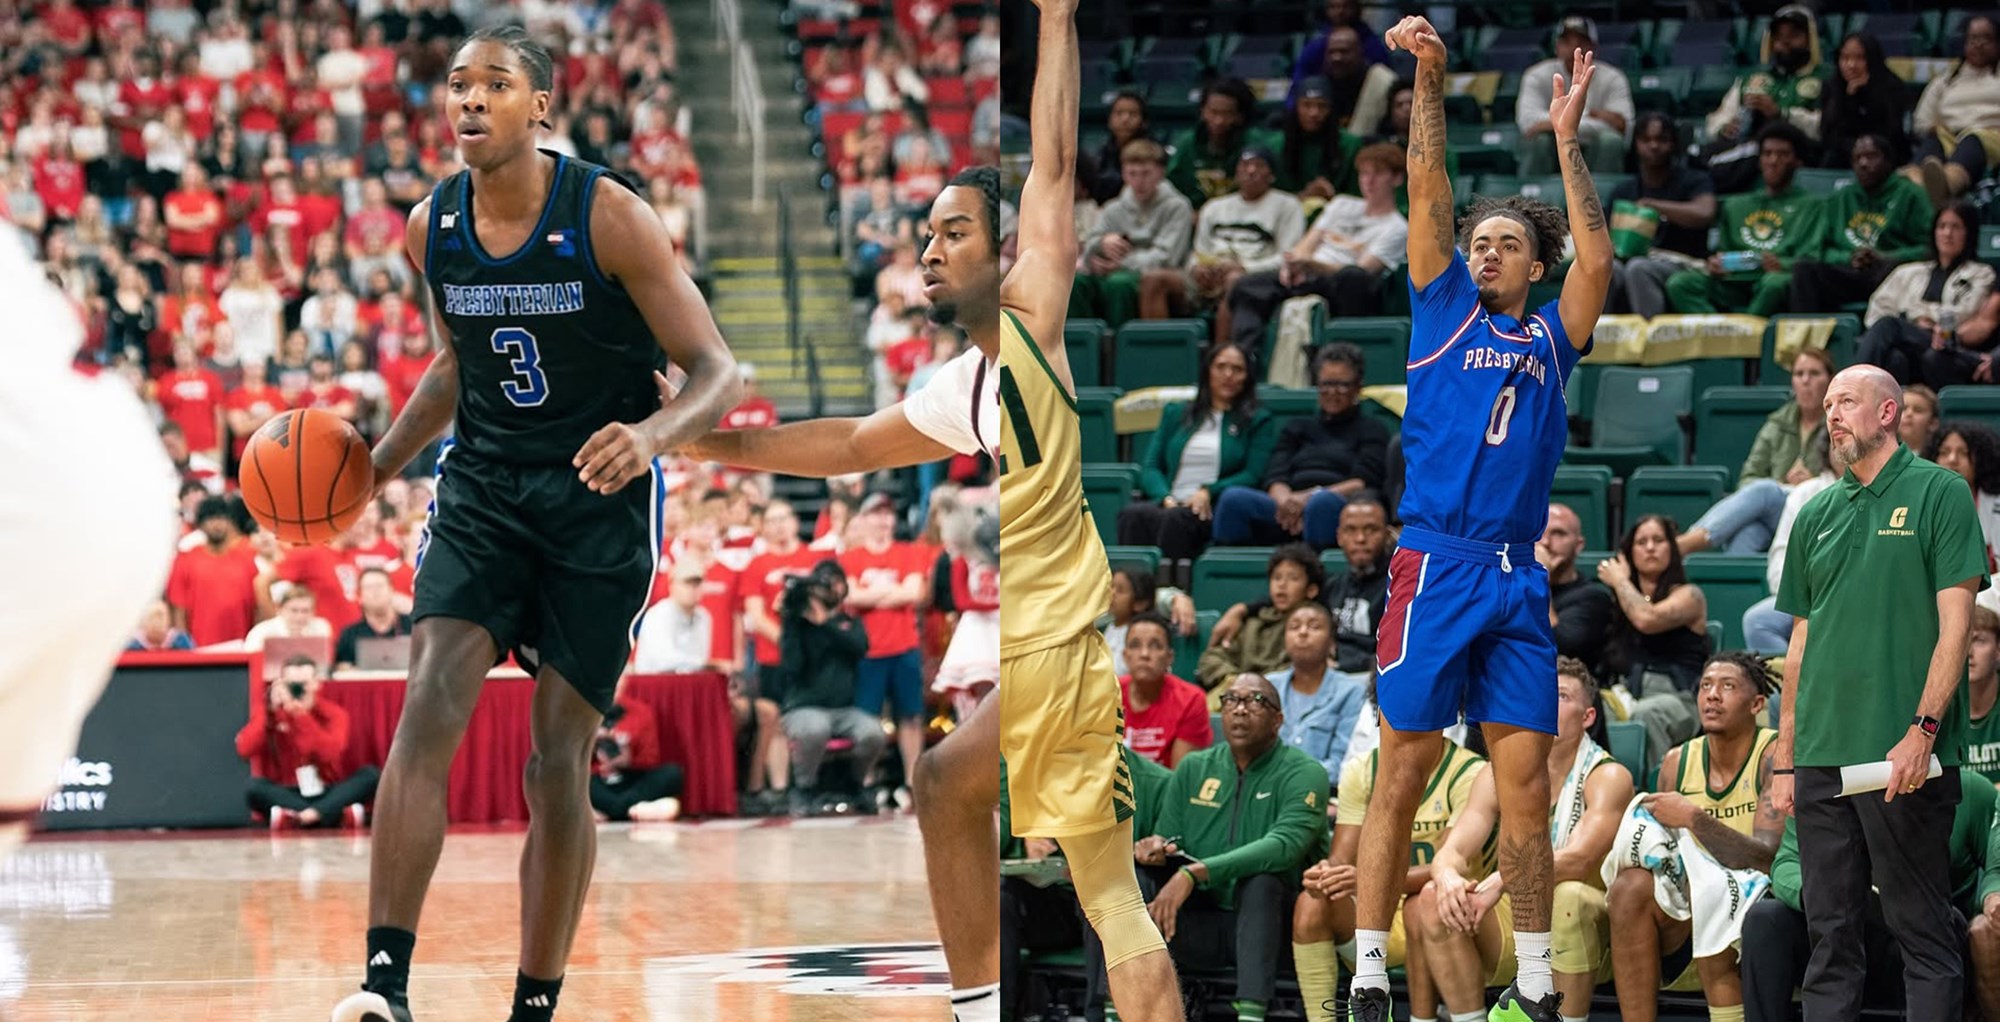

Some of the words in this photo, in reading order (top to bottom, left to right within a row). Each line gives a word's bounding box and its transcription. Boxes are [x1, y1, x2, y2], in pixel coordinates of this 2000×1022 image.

[443, 281, 585, 316] PRESBYTERIAN
[490, 327, 550, 407] 3
[1000, 364, 1043, 476] 1
[1485, 386, 1516, 446] 0
